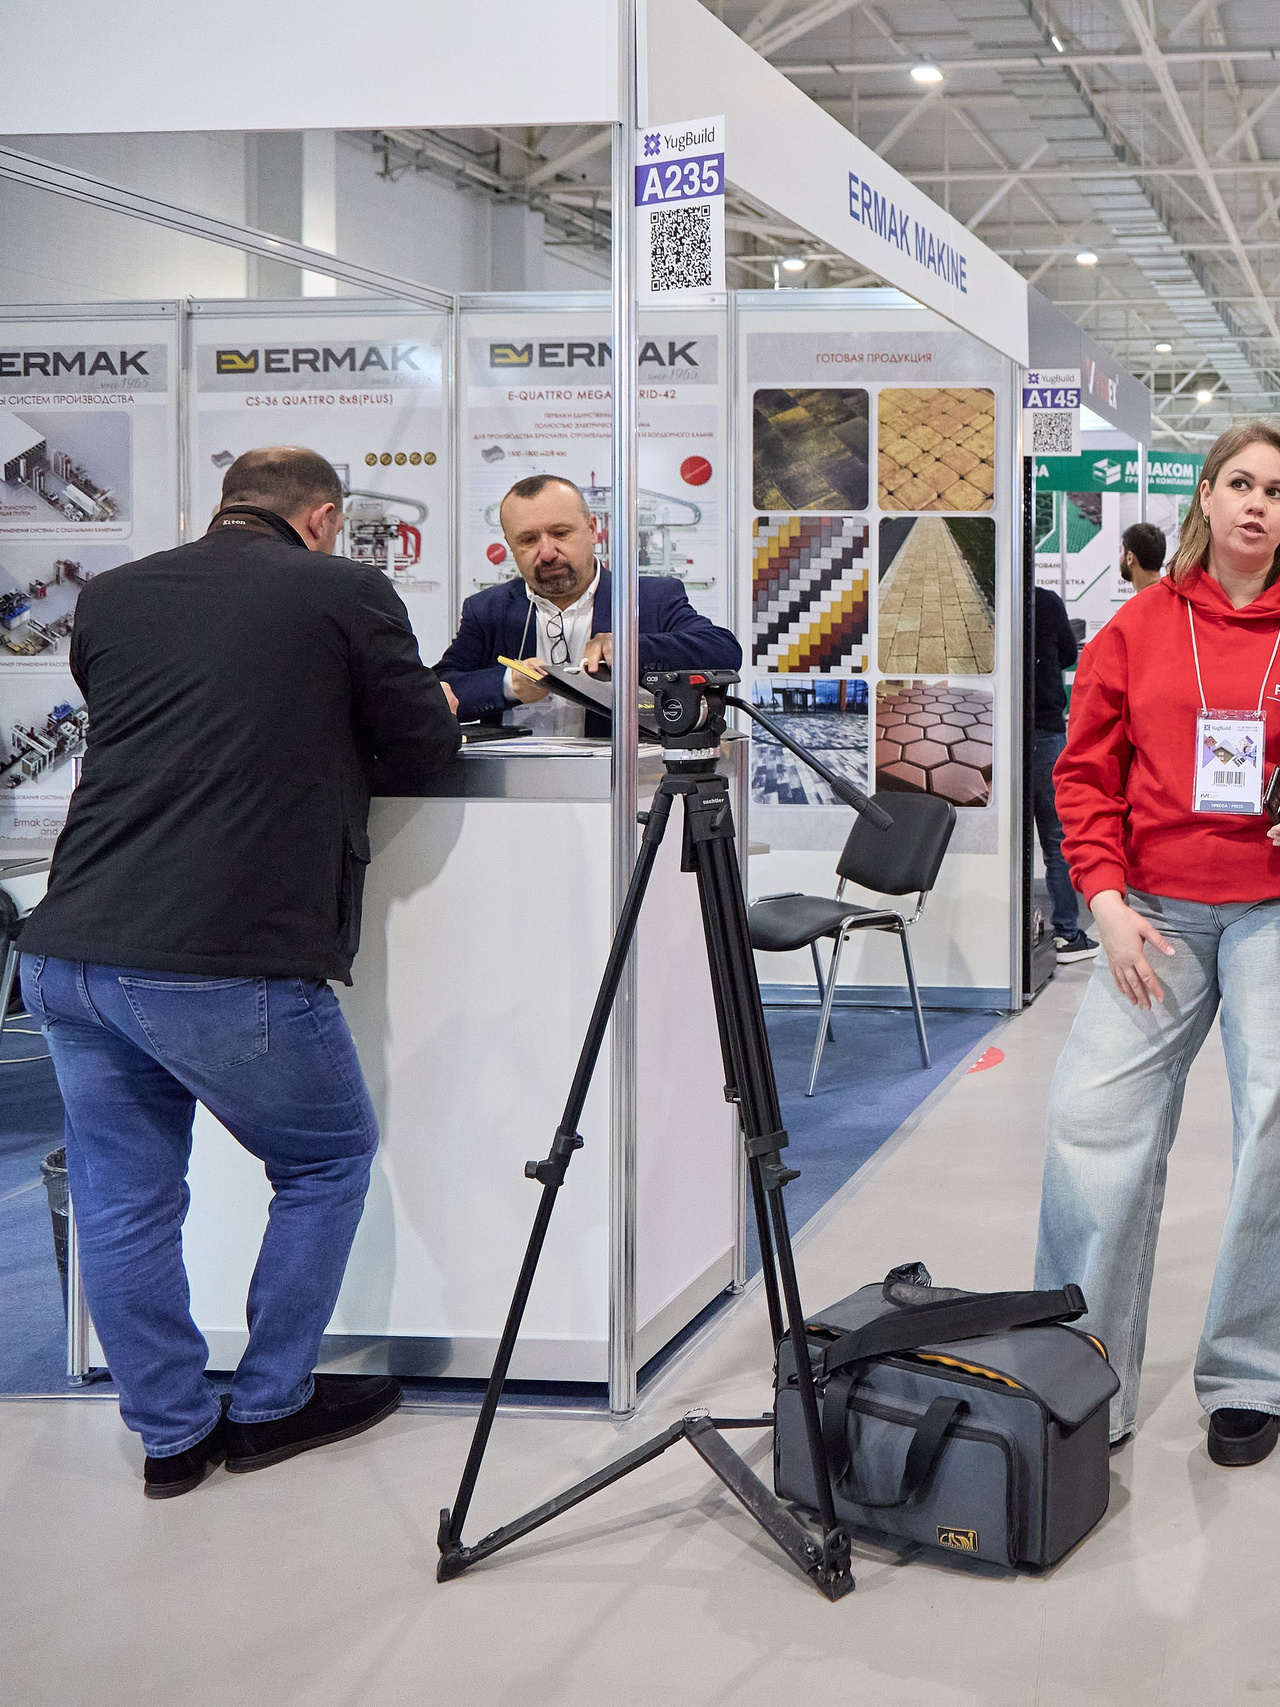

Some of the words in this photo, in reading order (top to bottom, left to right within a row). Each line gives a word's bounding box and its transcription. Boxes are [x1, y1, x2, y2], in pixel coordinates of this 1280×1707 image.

[664, 127, 715, 152] YugBuild
[641, 159, 720, 202] A235
[848, 171, 912, 256] ERMAK
[914, 221, 968, 294] MAKINE
[0, 350, 149, 377] ERMAK
[264, 347, 421, 373] ERMAK
[816, 353, 864, 363] ГОТОВАЯ
[867, 352, 932, 364] ПРОДУКЦИЯ
[1041, 374, 1075, 384] YugBuild
[9, 395, 50, 405] СИСТЕМ
[53, 395, 134, 405] ПРОИЗВОДСТВА
[246, 396, 278, 406] CS-36
[282, 395, 335, 405] QUATTRO
[508, 390, 572, 400] E-QUATTRO
[577, 389, 612, 400] MEGA
[1027, 390, 1078, 407] A145
[1125, 461, 1194, 478] МАКОМ
[14, 818, 40, 827] Ermak
